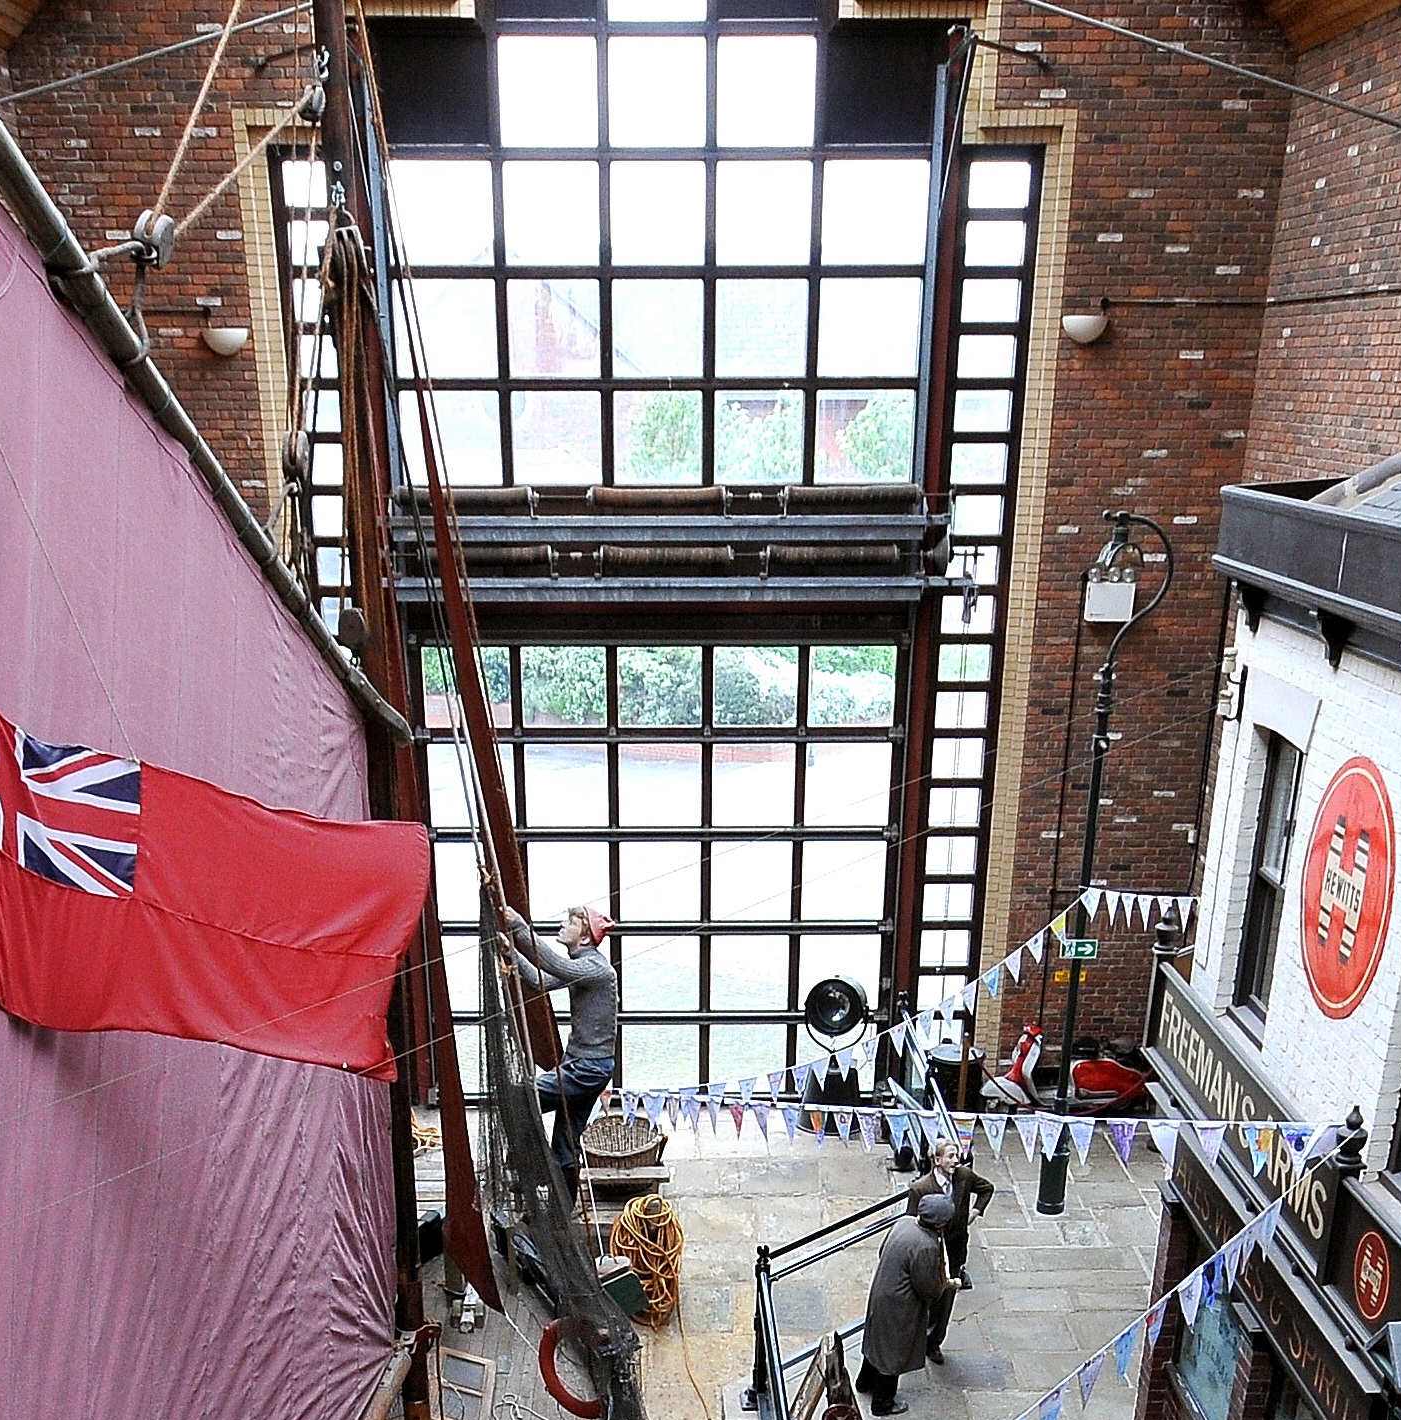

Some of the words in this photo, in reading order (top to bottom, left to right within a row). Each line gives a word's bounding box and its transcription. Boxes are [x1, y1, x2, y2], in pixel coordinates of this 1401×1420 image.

[1325, 869, 1361, 913] HEWITTS
[1159, 990, 1255, 1148] FREEMAN'S
[1267, 1114, 1327, 1240] ARMS
